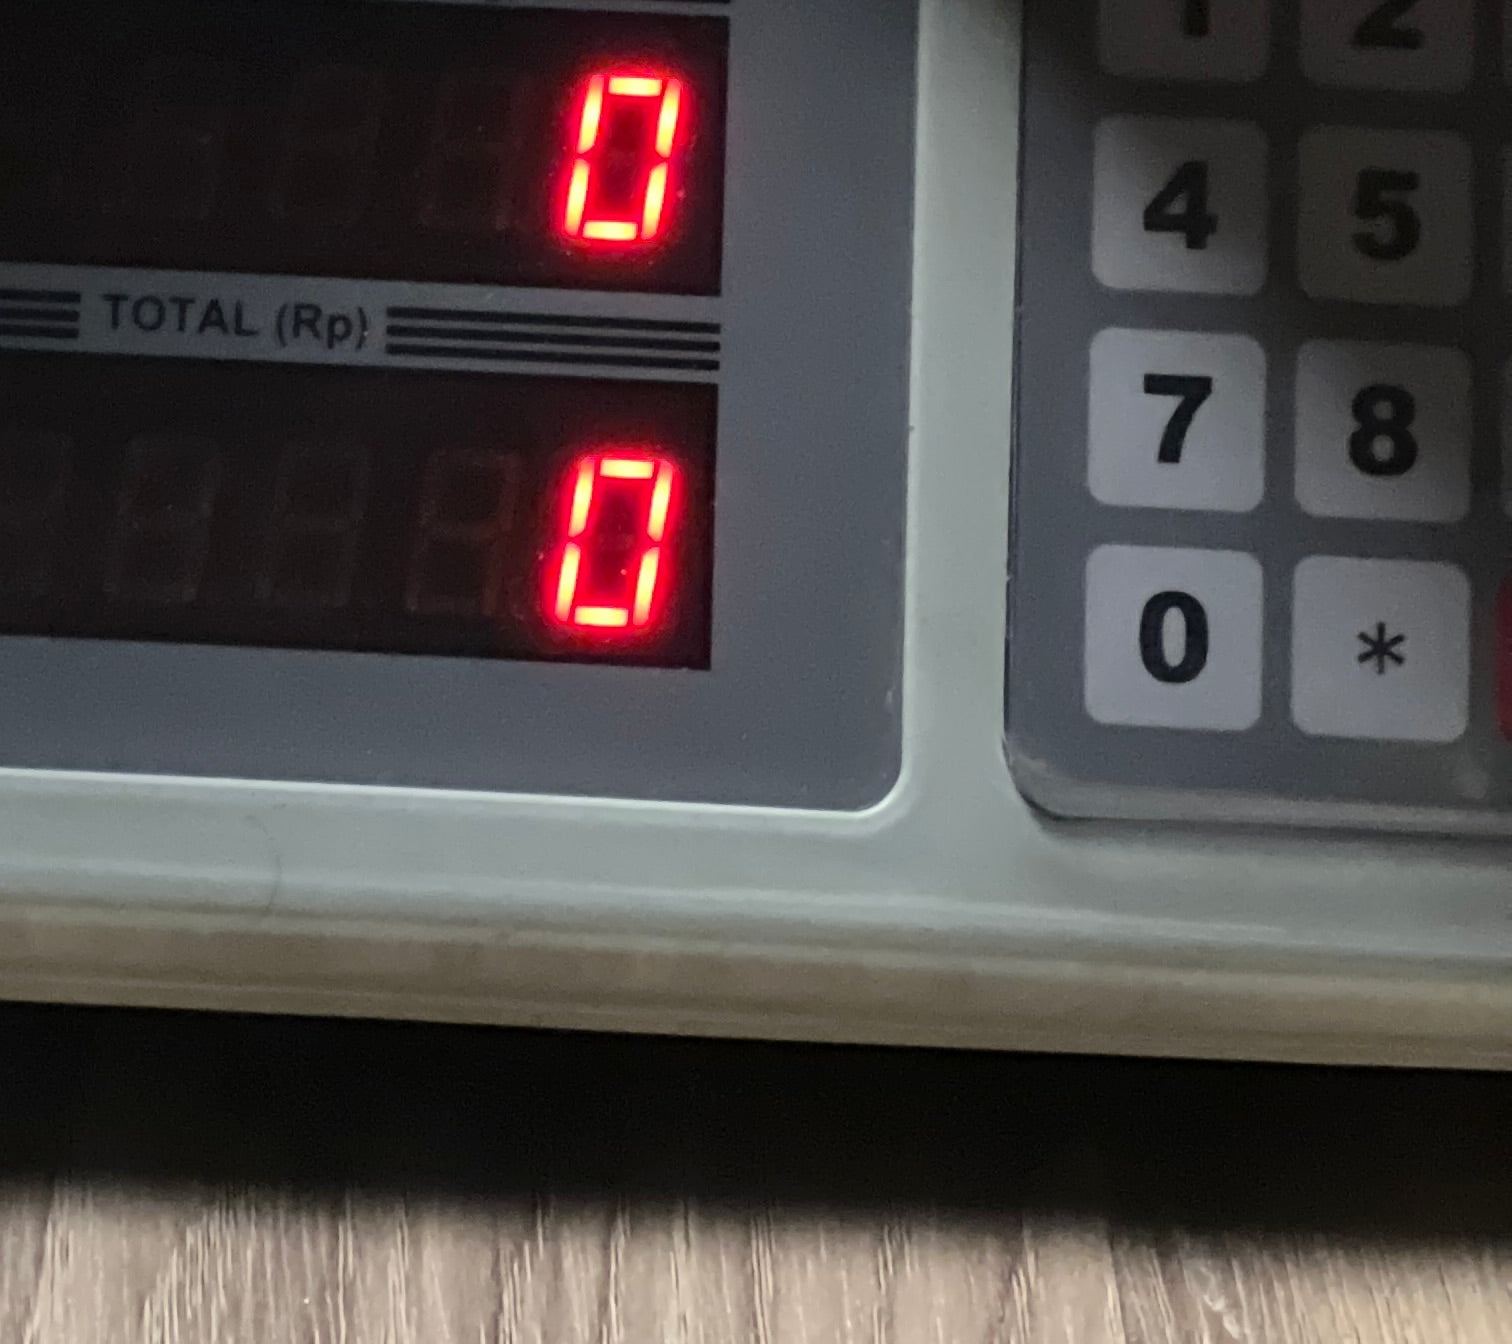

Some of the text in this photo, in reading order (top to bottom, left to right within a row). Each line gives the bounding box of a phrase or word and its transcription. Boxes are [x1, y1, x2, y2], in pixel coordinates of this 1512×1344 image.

[562, 72, 684, 244] 0
[1143, 160, 1217, 250] 4
[1351, 169, 1421, 261] 5
[103, 292, 370, 350] TOTAL (Rp)
[1143, 374, 1213, 464] 7
[1348, 383, 1419, 476] 8
[555, 455, 675, 628] 0
[1139, 591, 1209, 683] 0
